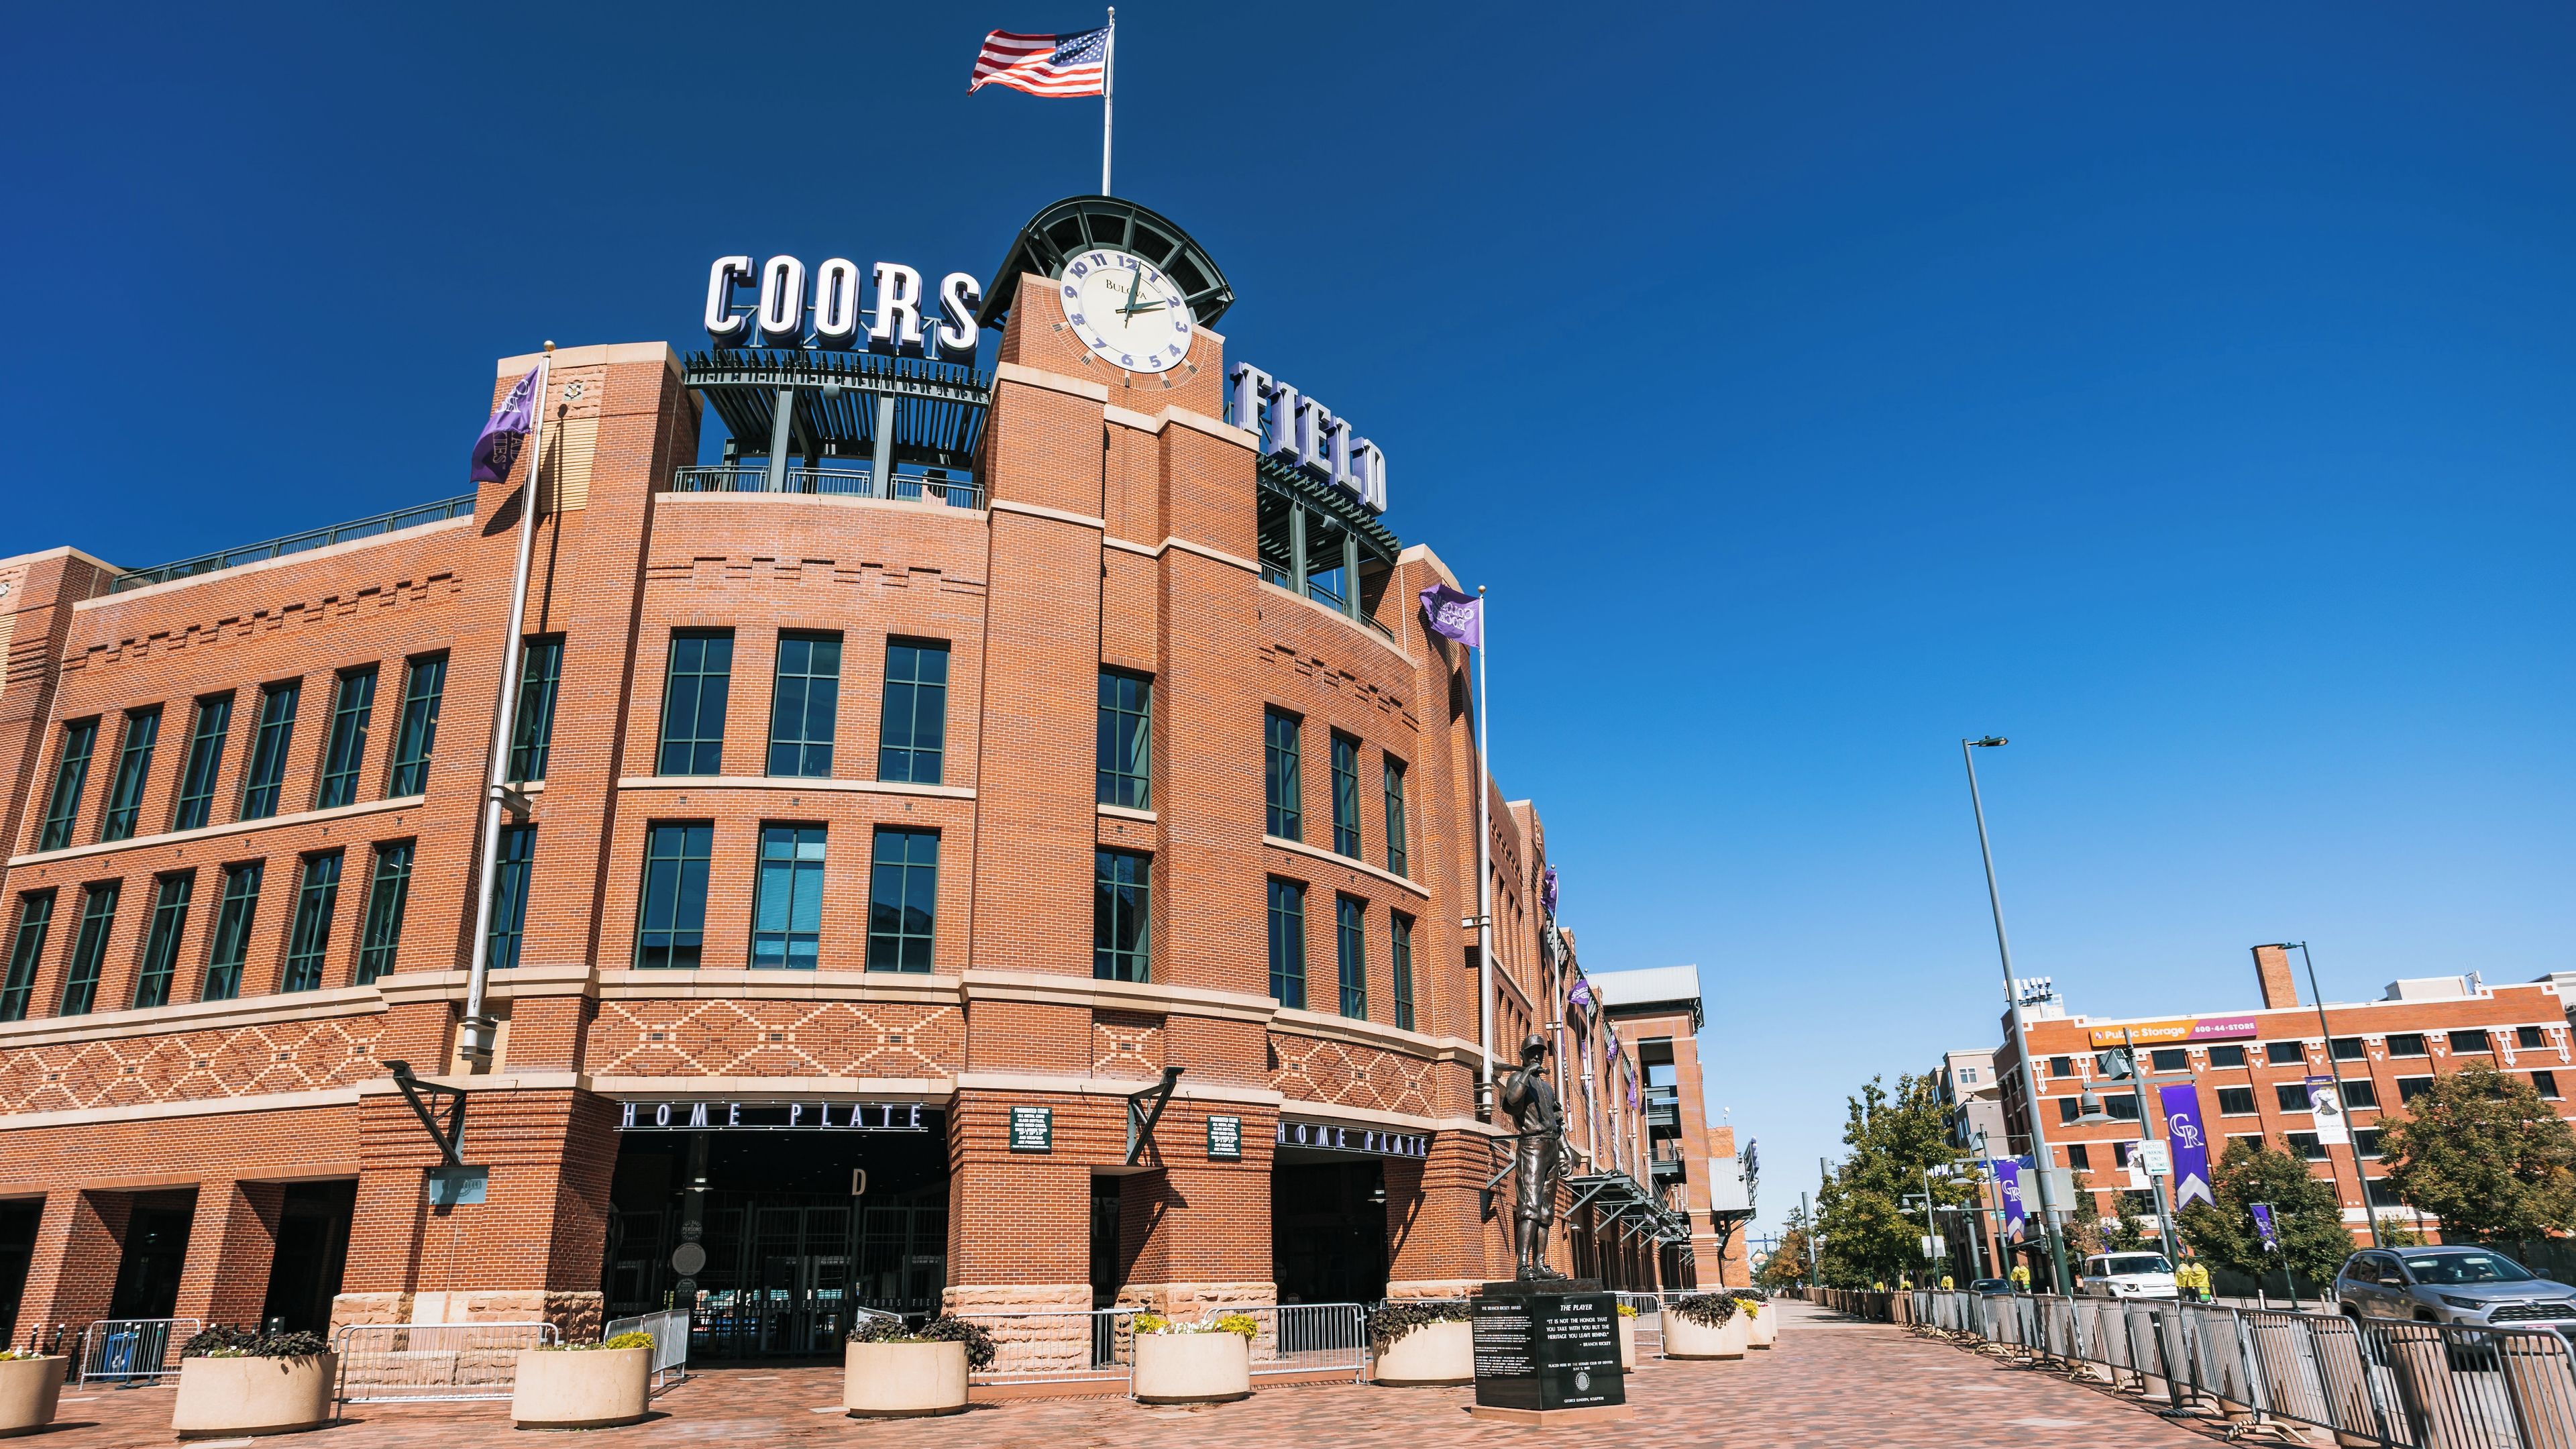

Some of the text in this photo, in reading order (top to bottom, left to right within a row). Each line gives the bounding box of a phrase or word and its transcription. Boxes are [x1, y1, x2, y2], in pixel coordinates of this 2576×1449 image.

[1089, 253, 1107, 267] 11
[1117, 255, 1138, 270] 12
[1069, 261, 1088, 279] 10
[1149, 270, 1159, 283] 1
[1064, 285, 1078, 299] 9
[704, 255, 981, 350] COORS
[1166, 296, 1181, 309] 2
[1071, 313, 1085, 327] 8
[1175, 321, 1188, 333] 3
[1091, 337, 1108, 350] 7
[1169, 343, 1181, 358] 4
[1121, 354, 1134, 366] 6
[1148, 355, 1162, 368] 5
[1230, 362, 1387, 512] FIELD
[2105, 1029, 2139, 1039] Pubic
[2141, 1026, 2185, 1038] Storage
[622, 1104, 920, 1128] HOME PLATE
[1277, 1122, 1426, 1157] HOME PLATE
[851, 1169, 866, 1195] D
[755, 1300, 836, 1309] COORS FIELD
